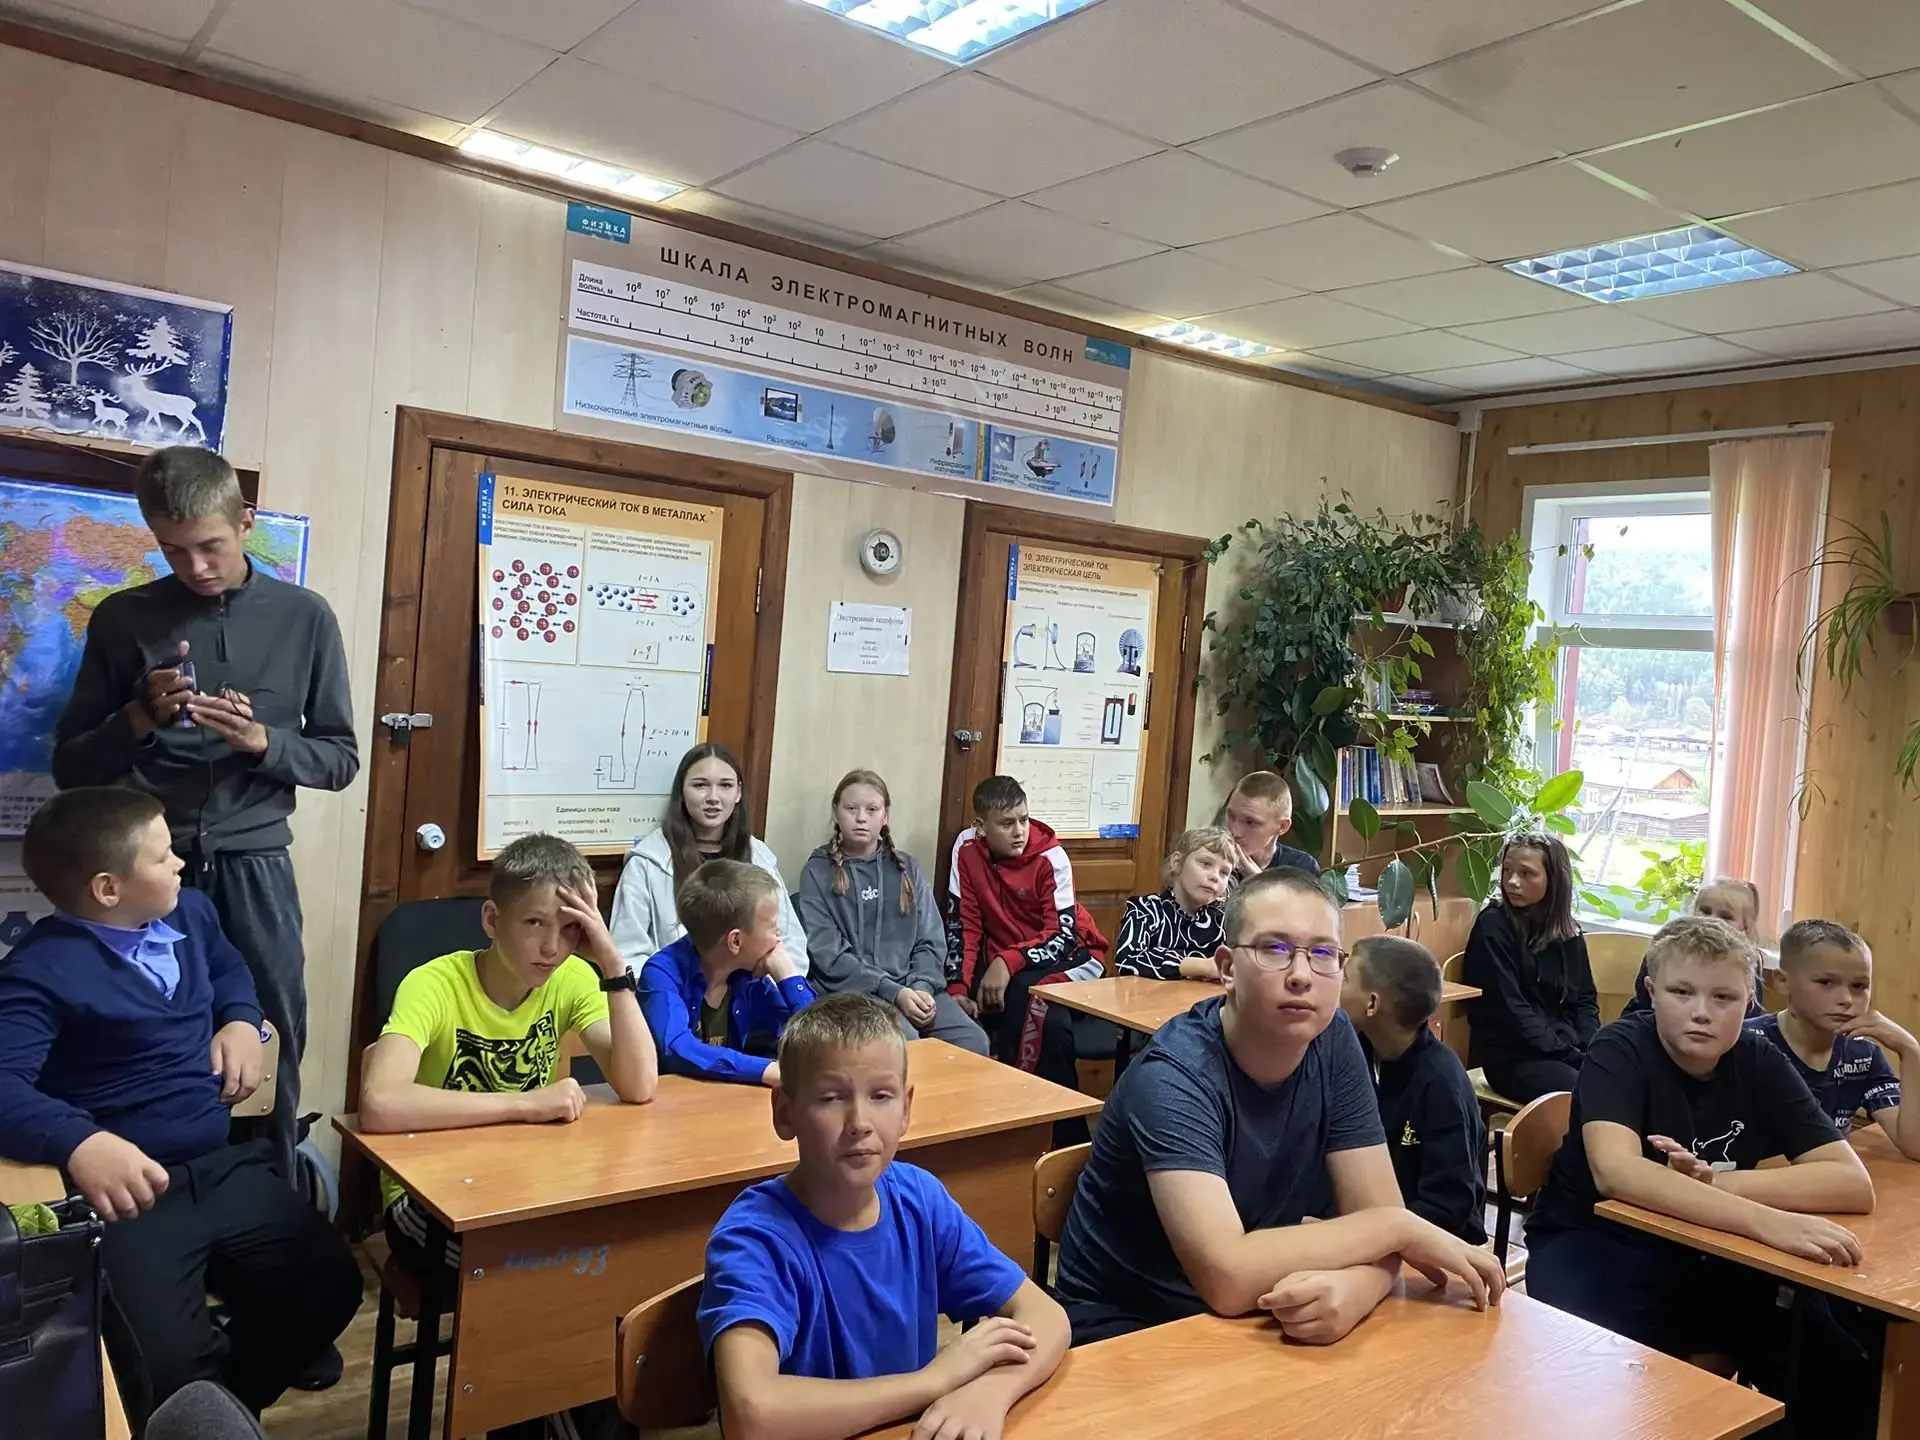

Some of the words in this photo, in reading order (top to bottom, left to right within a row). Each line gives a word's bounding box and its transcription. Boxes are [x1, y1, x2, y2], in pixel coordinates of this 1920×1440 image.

[578, 273, 603, 286] Длина
[660, 246, 749, 284] ШКАЛА
[771, 275, 1008, 348] ЭЛЕКТРОМАГНИТНЫХ
[1024, 339, 1073, 363] ВОЛН
[577, 308, 608, 322] Частота,
[610, 315, 620, 325] Гц
[814, 328, 824, 337] 10
[841, 334, 846, 342] 1
[574, 400, 638, 419] Низкочастотные
[640, 412, 709, 431] электромагнитные
[710, 424, 732, 435] волны
[502, 500, 534, 513] СИЛА
[538, 505, 566, 516] ТОКА
[504, 486, 518, 498] 11.
[522, 488, 617, 510] ЭЛЕКТРИЧЕСКИЙ
[620, 502, 640, 513] ТОК
[642, 506, 650, 514] В
[652, 506, 708, 523] МЕТАЛЛАХ.
[1024, 553, 1034, 562] 10.
[1036, 554, 1095, 570] ЭЛЕКТРИЧЕСКИЙ
[1096, 562, 1108, 570] ТОК
[1023, 564, 1082, 578] ЭЛЕКТРИЧЕСКАЯ
[1083, 570, 1102, 580] ЦЕПЬ
[556, 806, 586, 814] Единицы
